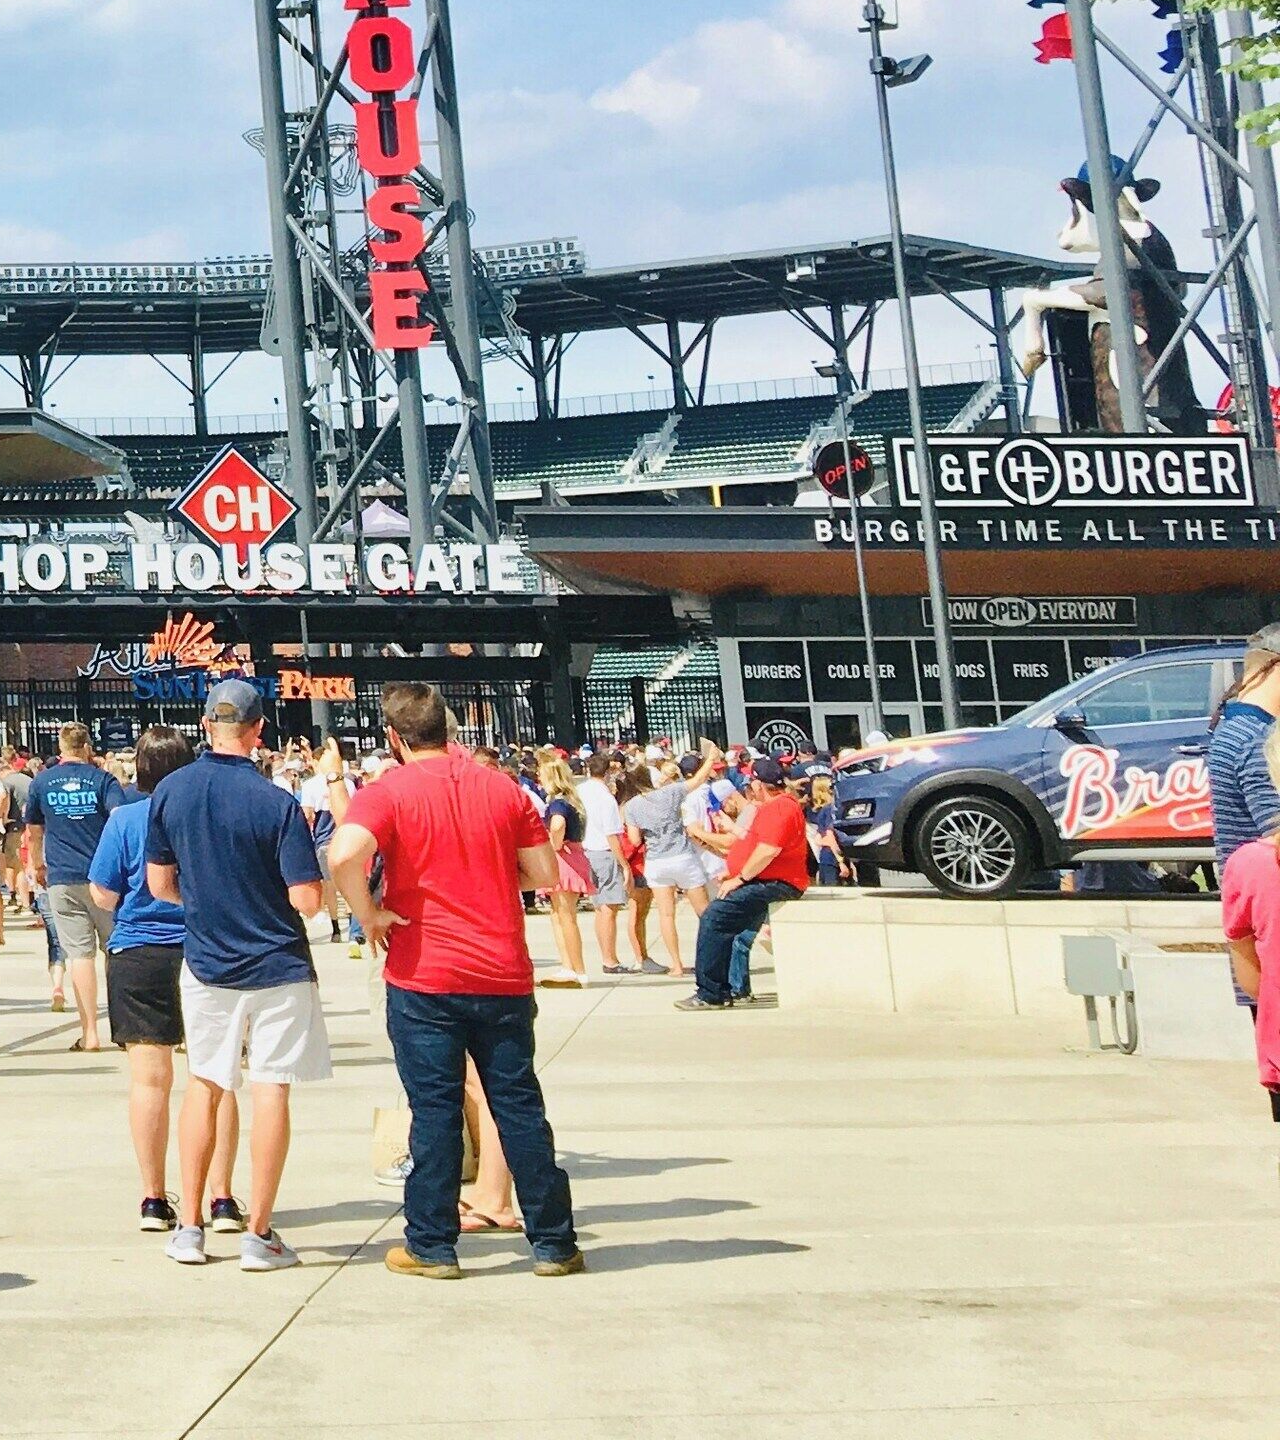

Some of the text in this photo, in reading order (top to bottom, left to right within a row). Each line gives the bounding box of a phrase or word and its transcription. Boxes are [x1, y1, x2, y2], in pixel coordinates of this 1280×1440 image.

[1063, 449, 1241, 495] BURGER
[203, 484, 274, 534] CH
[977, 519, 1062, 542] TIME
[1083, 518, 1145, 542] ALL
[1163, 518, 1228, 542] THE
[132, 543, 356, 592] HOUSE
[366, 543, 526, 592] GATE
[985, 601, 1029, 620] OPEN
[1039, 601, 1116, 620] EVERYDAY
[744, 664, 802, 679] BURGERS
[828, 664, 860, 679] COLD
[923, 664, 940, 678] HO
[1013, 663, 1050, 678] FRIES
[1083, 656, 1130, 669] CHICK
[133, 669, 357, 700] SUNTST PARK
[771, 723, 804, 744] BURGE
[47, 790, 98, 806] COSTA
